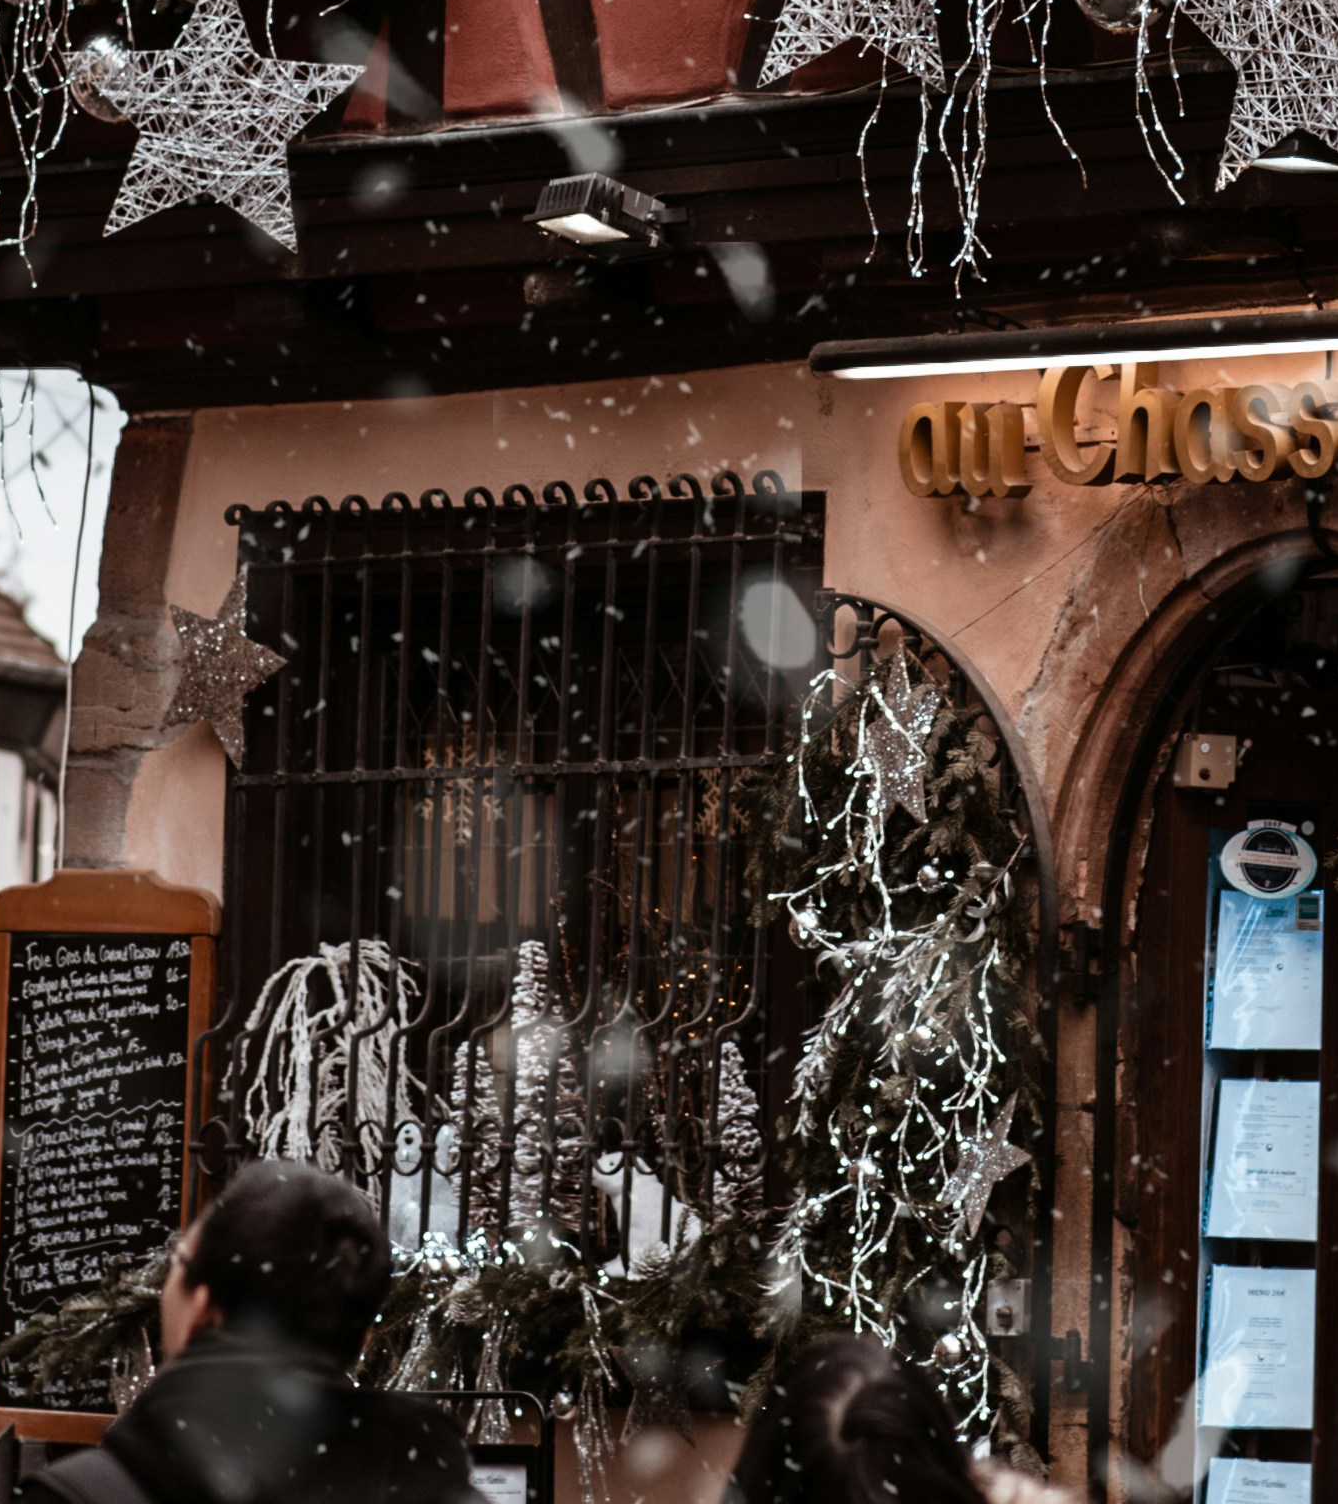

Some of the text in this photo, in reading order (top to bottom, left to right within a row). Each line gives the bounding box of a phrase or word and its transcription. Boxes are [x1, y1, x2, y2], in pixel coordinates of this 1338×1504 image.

[899, 399, 1032, 498] au
[26, 941, 52, 971] Foie
[56, 946, 81, 967] Gras
[22, 1039, 34, 1061] Le
[84, 1227, 97, 1242] DE
[100, 1224, 111, 1237] LA
[1247, 1288, 1270, 1297] MENU
